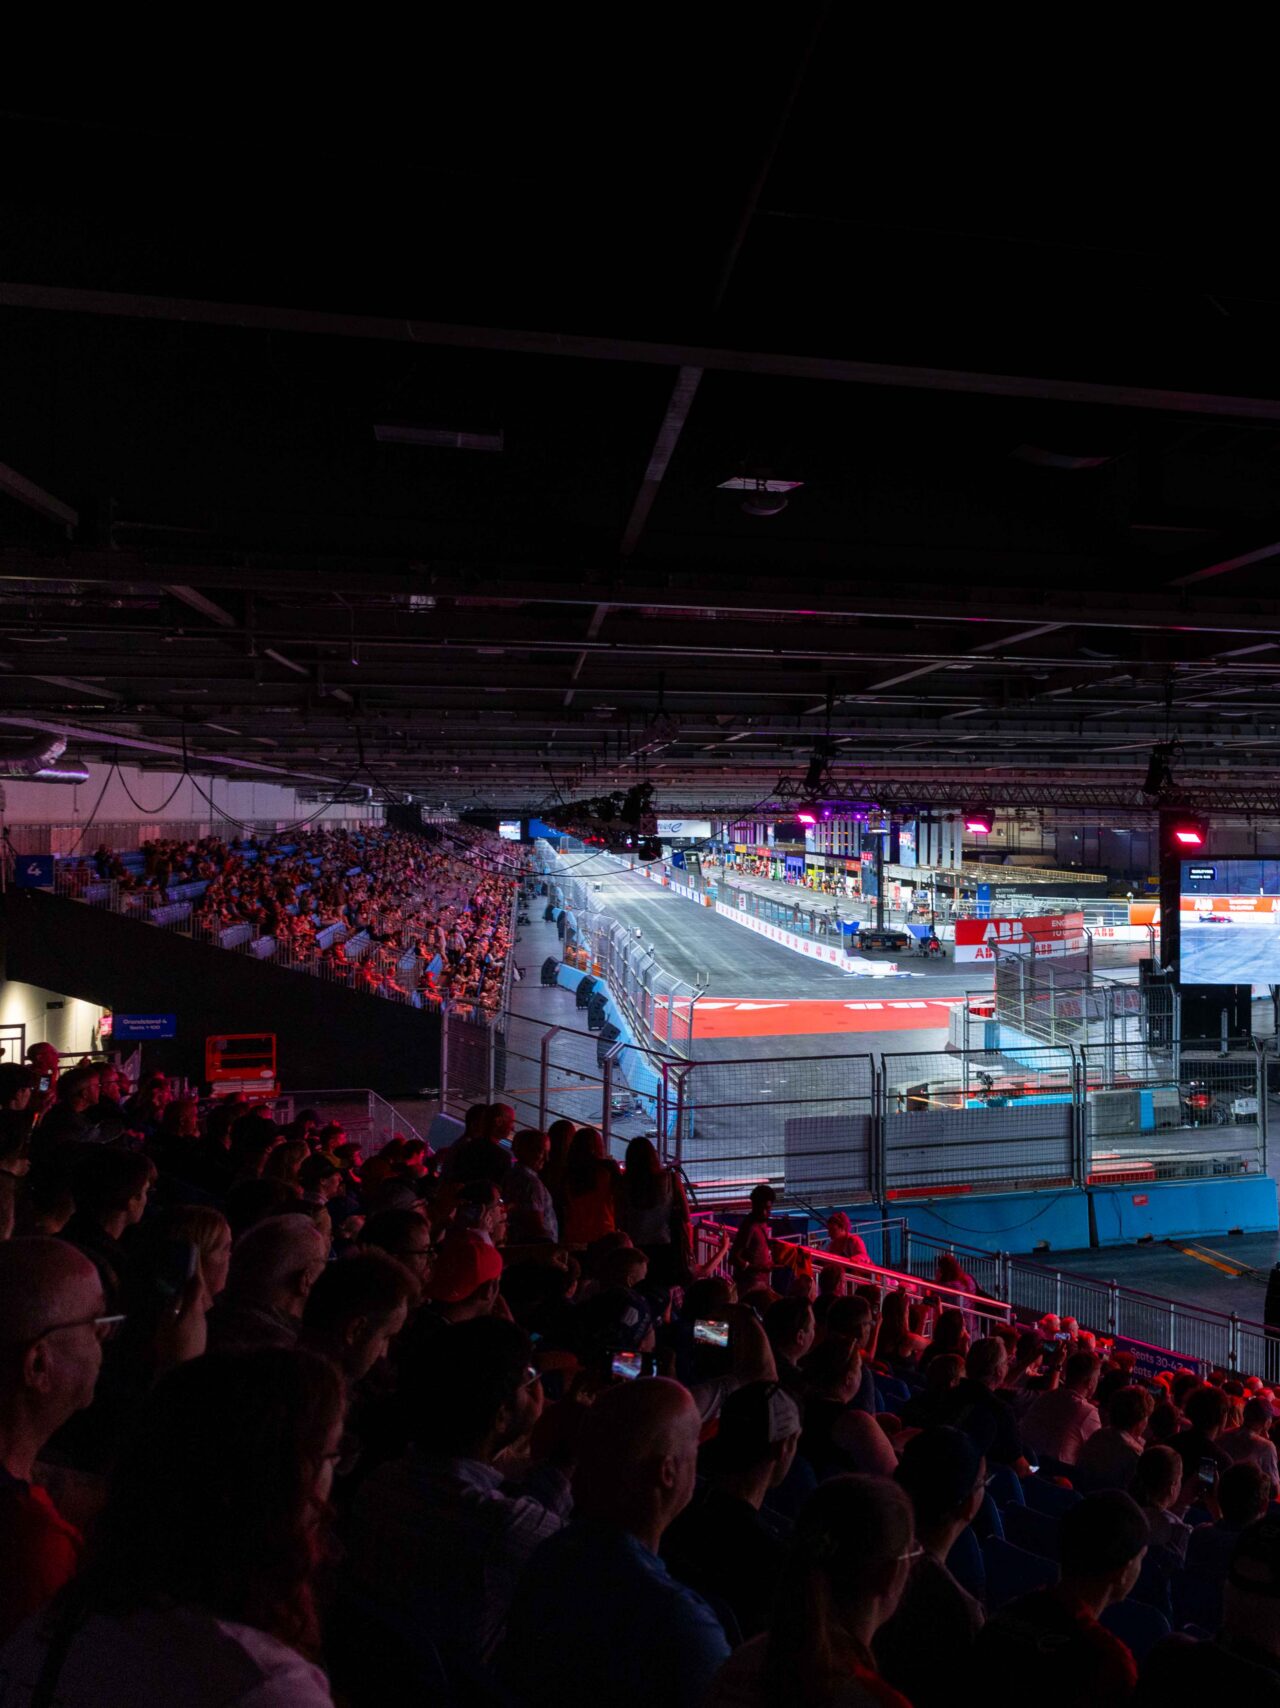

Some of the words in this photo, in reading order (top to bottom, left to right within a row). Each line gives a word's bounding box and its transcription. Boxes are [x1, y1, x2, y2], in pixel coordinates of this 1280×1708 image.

[27, 862, 42, 876] 4
[982, 922, 1024, 941] ABB
[1094, 927, 1115, 938] ABB
